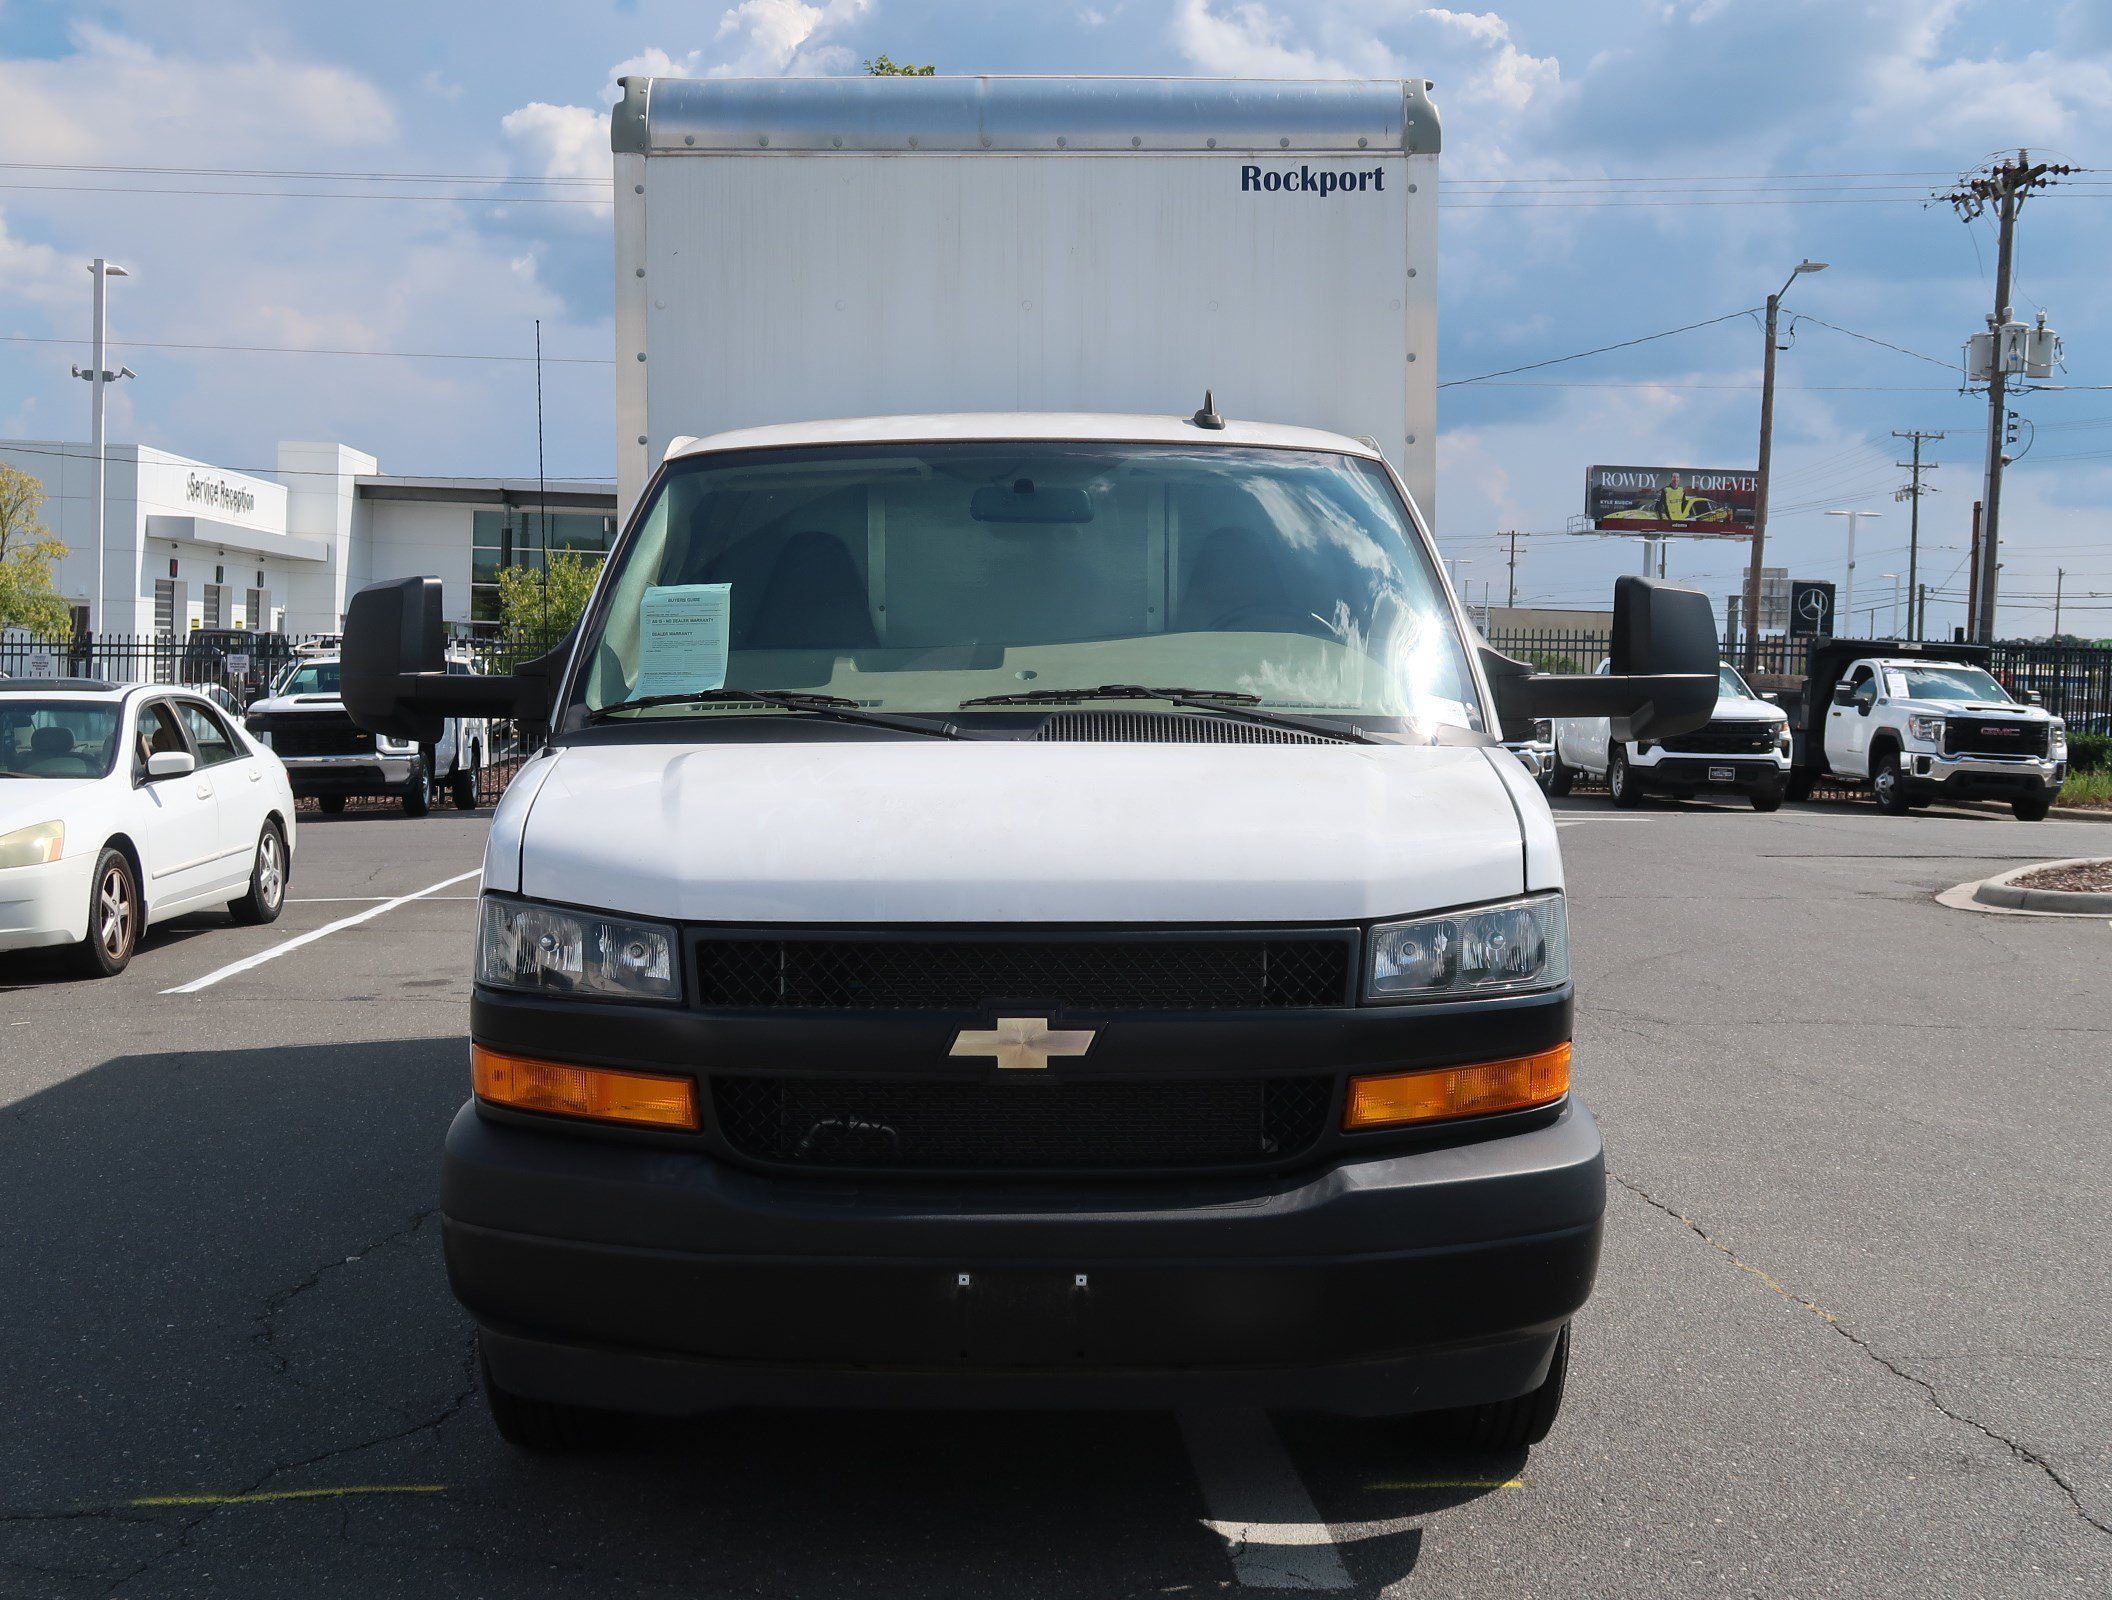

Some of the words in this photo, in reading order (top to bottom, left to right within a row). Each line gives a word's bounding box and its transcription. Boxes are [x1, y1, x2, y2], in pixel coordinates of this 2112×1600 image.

[1241, 165, 1385, 198] Rockport
[1601, 471, 1660, 488] ROWDY
[189, 472, 218, 503] Service
[220, 480, 254, 513] Reception
[1980, 727, 2020, 736] GMC
